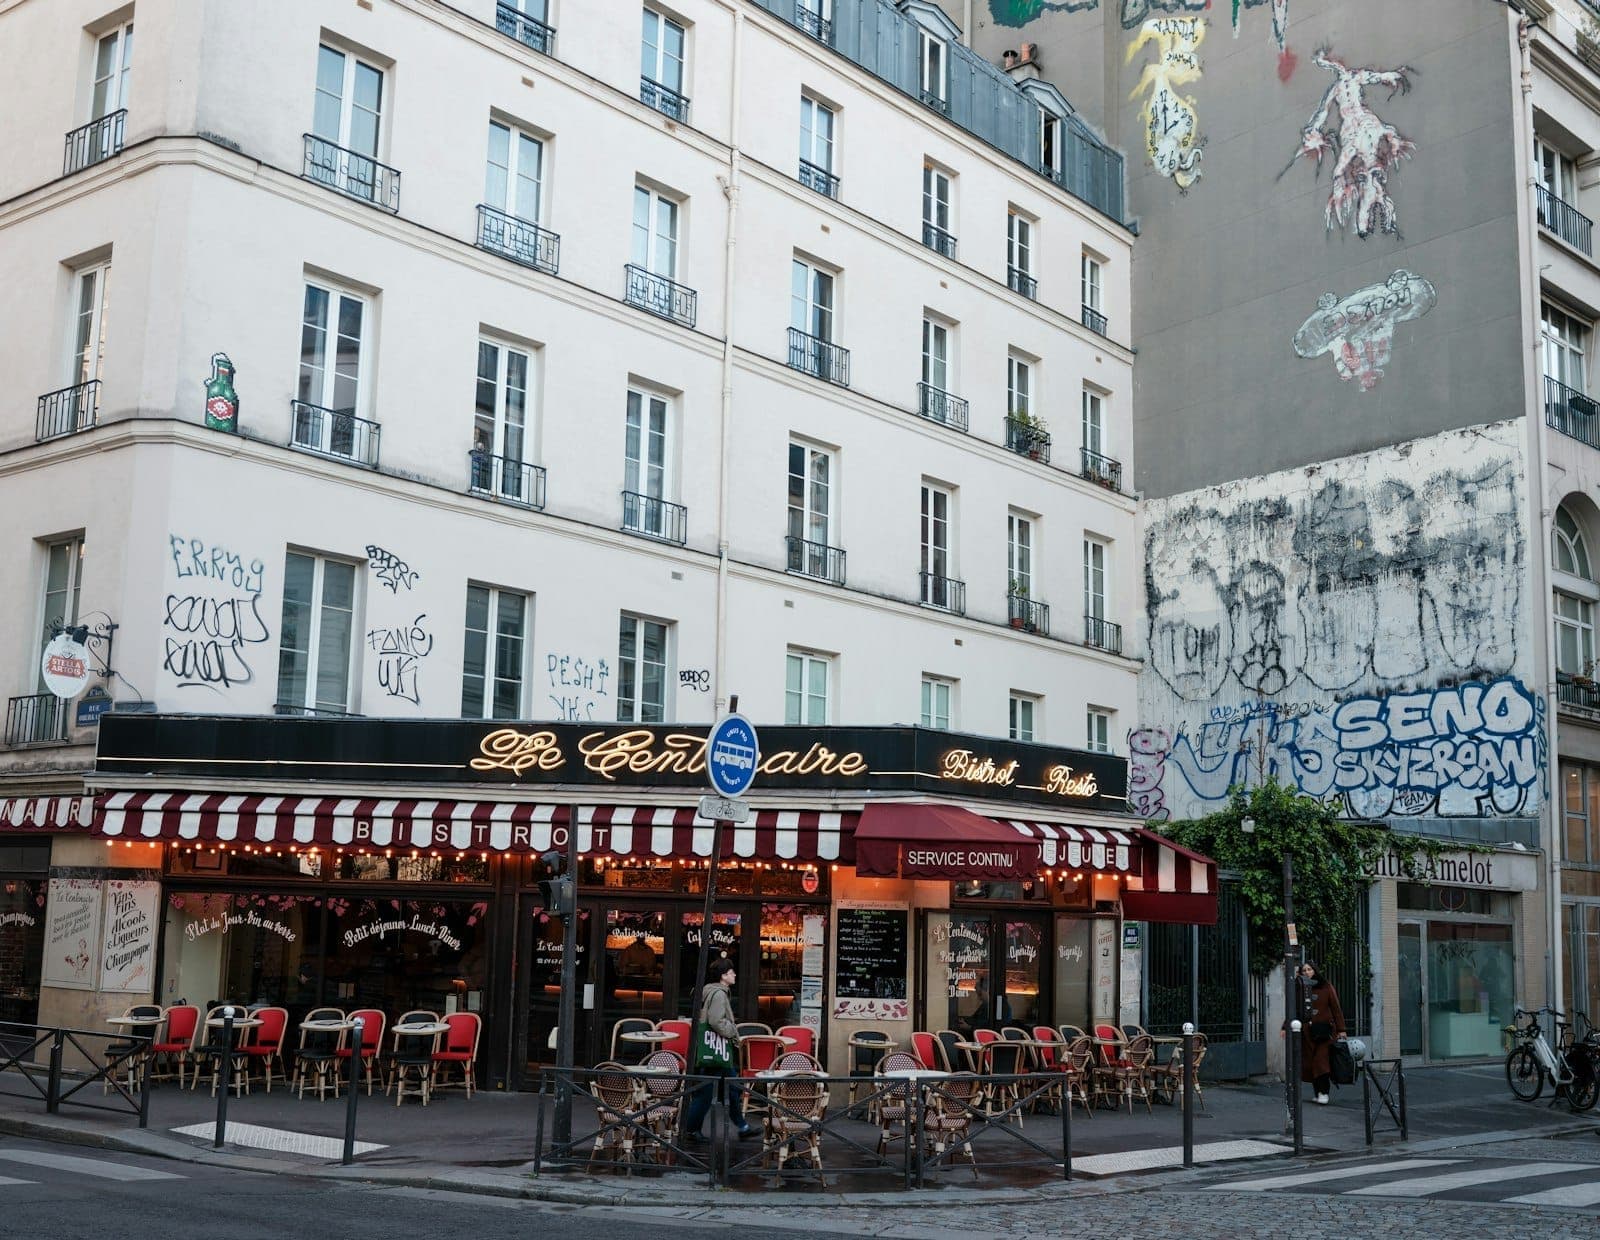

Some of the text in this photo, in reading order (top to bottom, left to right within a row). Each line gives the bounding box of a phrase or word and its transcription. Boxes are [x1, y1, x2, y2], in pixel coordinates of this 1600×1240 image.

[51, 665, 81, 675] ARTOIS
[52, 658, 81, 668] STELLA
[1333, 676, 1536, 750] SENO
[470, 728, 868, 782] Le Centaire
[943, 750, 1020, 787] Bistrot
[1047, 765, 1099, 797] Resto
[1, 801, 97, 822] NAIR
[356, 821, 609, 847] BISTROT
[908, 850, 1013, 868] SERVICE CONTINU
[1424, 851, 1494, 885] Amelot
[112, 891, 133, 907] Vins
[115, 899, 136, 915] Fins
[112, 911, 146, 934] Alcools
[185, 918, 210, 941] Plat
[210, 917, 220, 929] du
[221, 911, 243, 933] Jour
[263, 920, 273, 930] au
[344, 927, 369, 947] Petit
[370, 918, 406, 940] déjeuner
[409, 914, 435, 936] Lunch
[113, 926, 149, 948] Liqueurs
[106, 943, 150, 971] Champagne
[704, 1030, 730, 1062] CRAC
